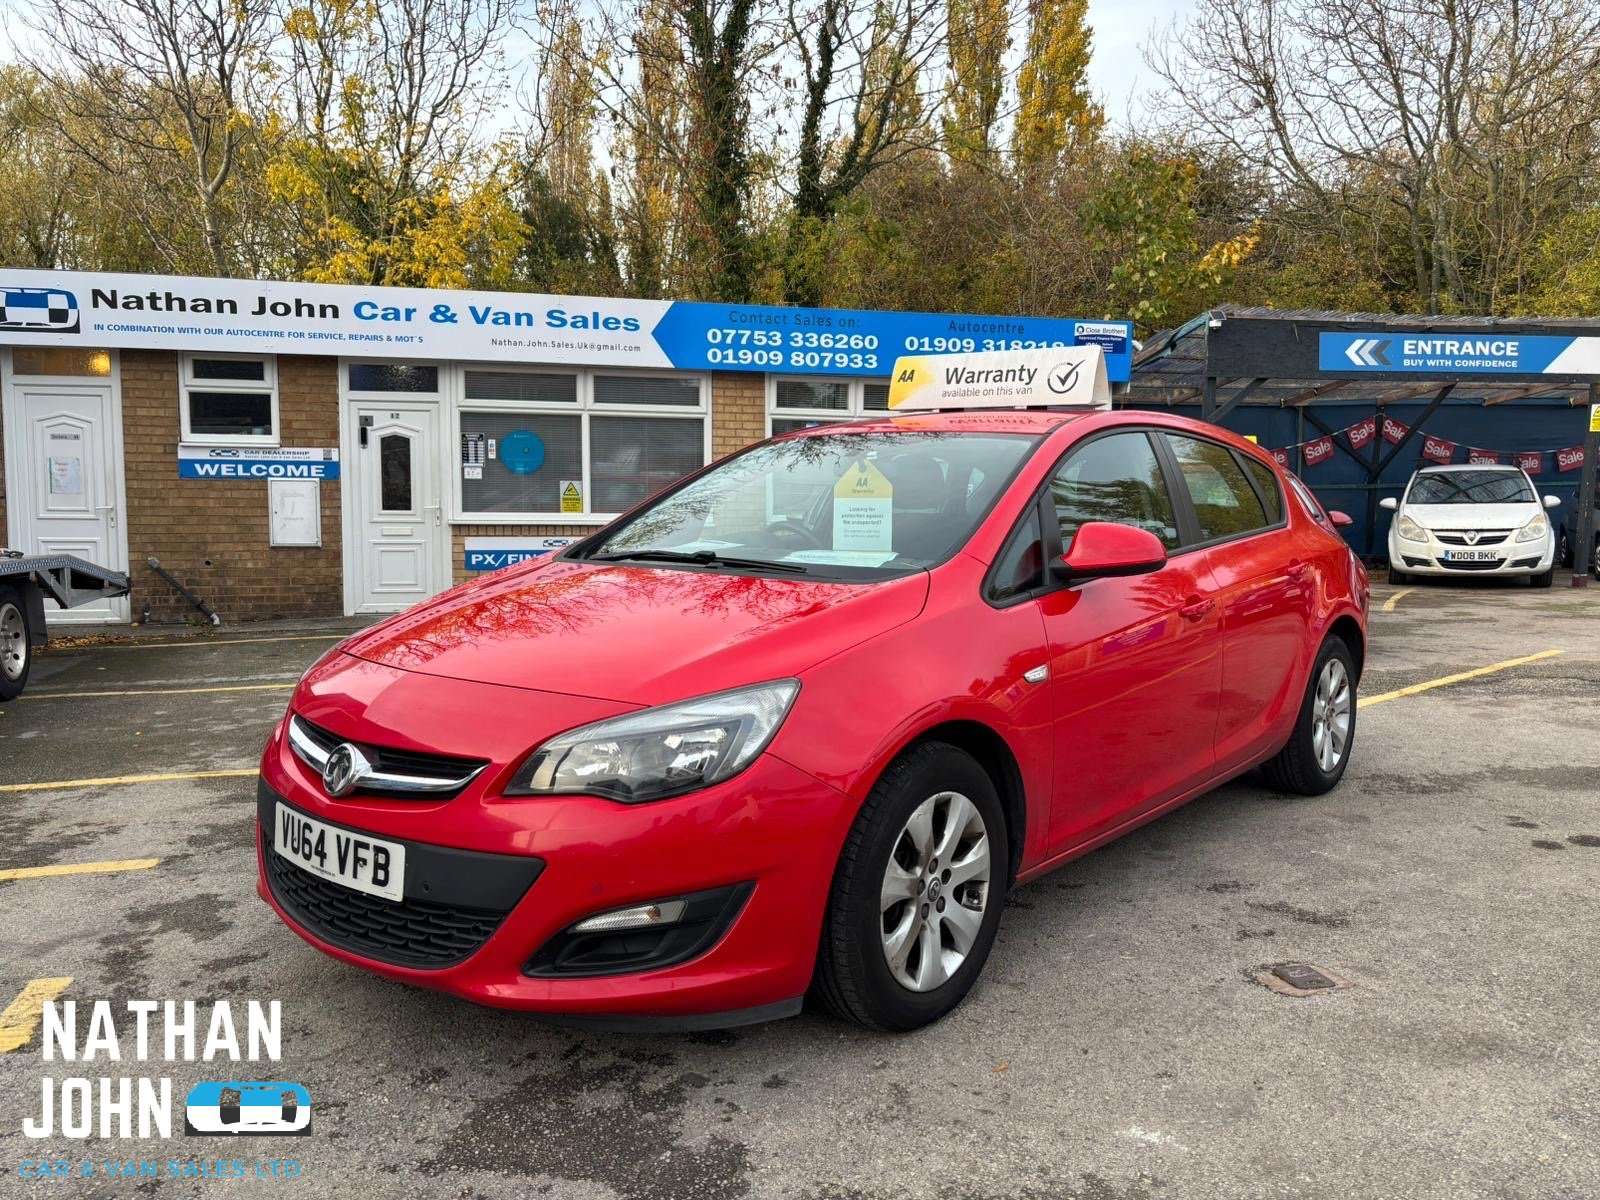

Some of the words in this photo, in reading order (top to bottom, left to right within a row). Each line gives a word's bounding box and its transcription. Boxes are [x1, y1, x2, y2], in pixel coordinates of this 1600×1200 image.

[91, 288, 238, 314] Nathan
[251, 296, 340, 319] John
[354, 301, 416, 322] Car
[428, 304, 458, 324] &
[468, 305, 534, 327] Van
[545, 309, 641, 332] Sales
[729, 311, 787, 325] Contact
[794, 313, 832, 327] Sales
[949, 319, 1025, 334] Autocentre
[94, 323, 105, 332] IN
[107, 324, 175, 334] COMBINATION
[177, 326, 202, 335] WITH
[203, 328, 224, 336] OUR
[226, 328, 285, 338] AUTOCENTRE
[288, 331, 306, 339] FOR
[308, 332, 346, 341] SERVICE,
[348, 334, 384, 342] REPAIRS
[706, 328, 783, 346] 07753
[789, 331, 879, 349] 336260
[1102, 327, 1126, 335] Brothers
[904, 336, 976, 352] 01909
[1403, 340, 1519, 356] ENTRANCE
[706, 348, 783, 366] 01909
[790, 351, 879, 369] 807933
[1403, 359, 1424, 367] BUY
[1426, 359, 1452, 367] WITH
[1454, 359, 1519, 368] CONFIDENCE
[897, 369, 915, 383] AA
[945, 365, 1038, 386] Warranty
[941, 386, 980, 399] available
[982, 389, 994, 397] on
[996, 386, 1014, 397] this
[1016, 387, 1033, 396] van
[1350, 423, 1376, 443] Sale
[1305, 441, 1331, 459] Sale
[1425, 440, 1451, 458] Sale
[1521, 457, 1538, 470] ale
[1559, 450, 1585, 465] Sale
[194, 463, 325, 477] WELCOME
[856, 477, 869, 488] AA
[1478, 551, 1497, 560] BKK
[282, 809, 327, 868] VU64
[336, 834, 390, 888] VFB
